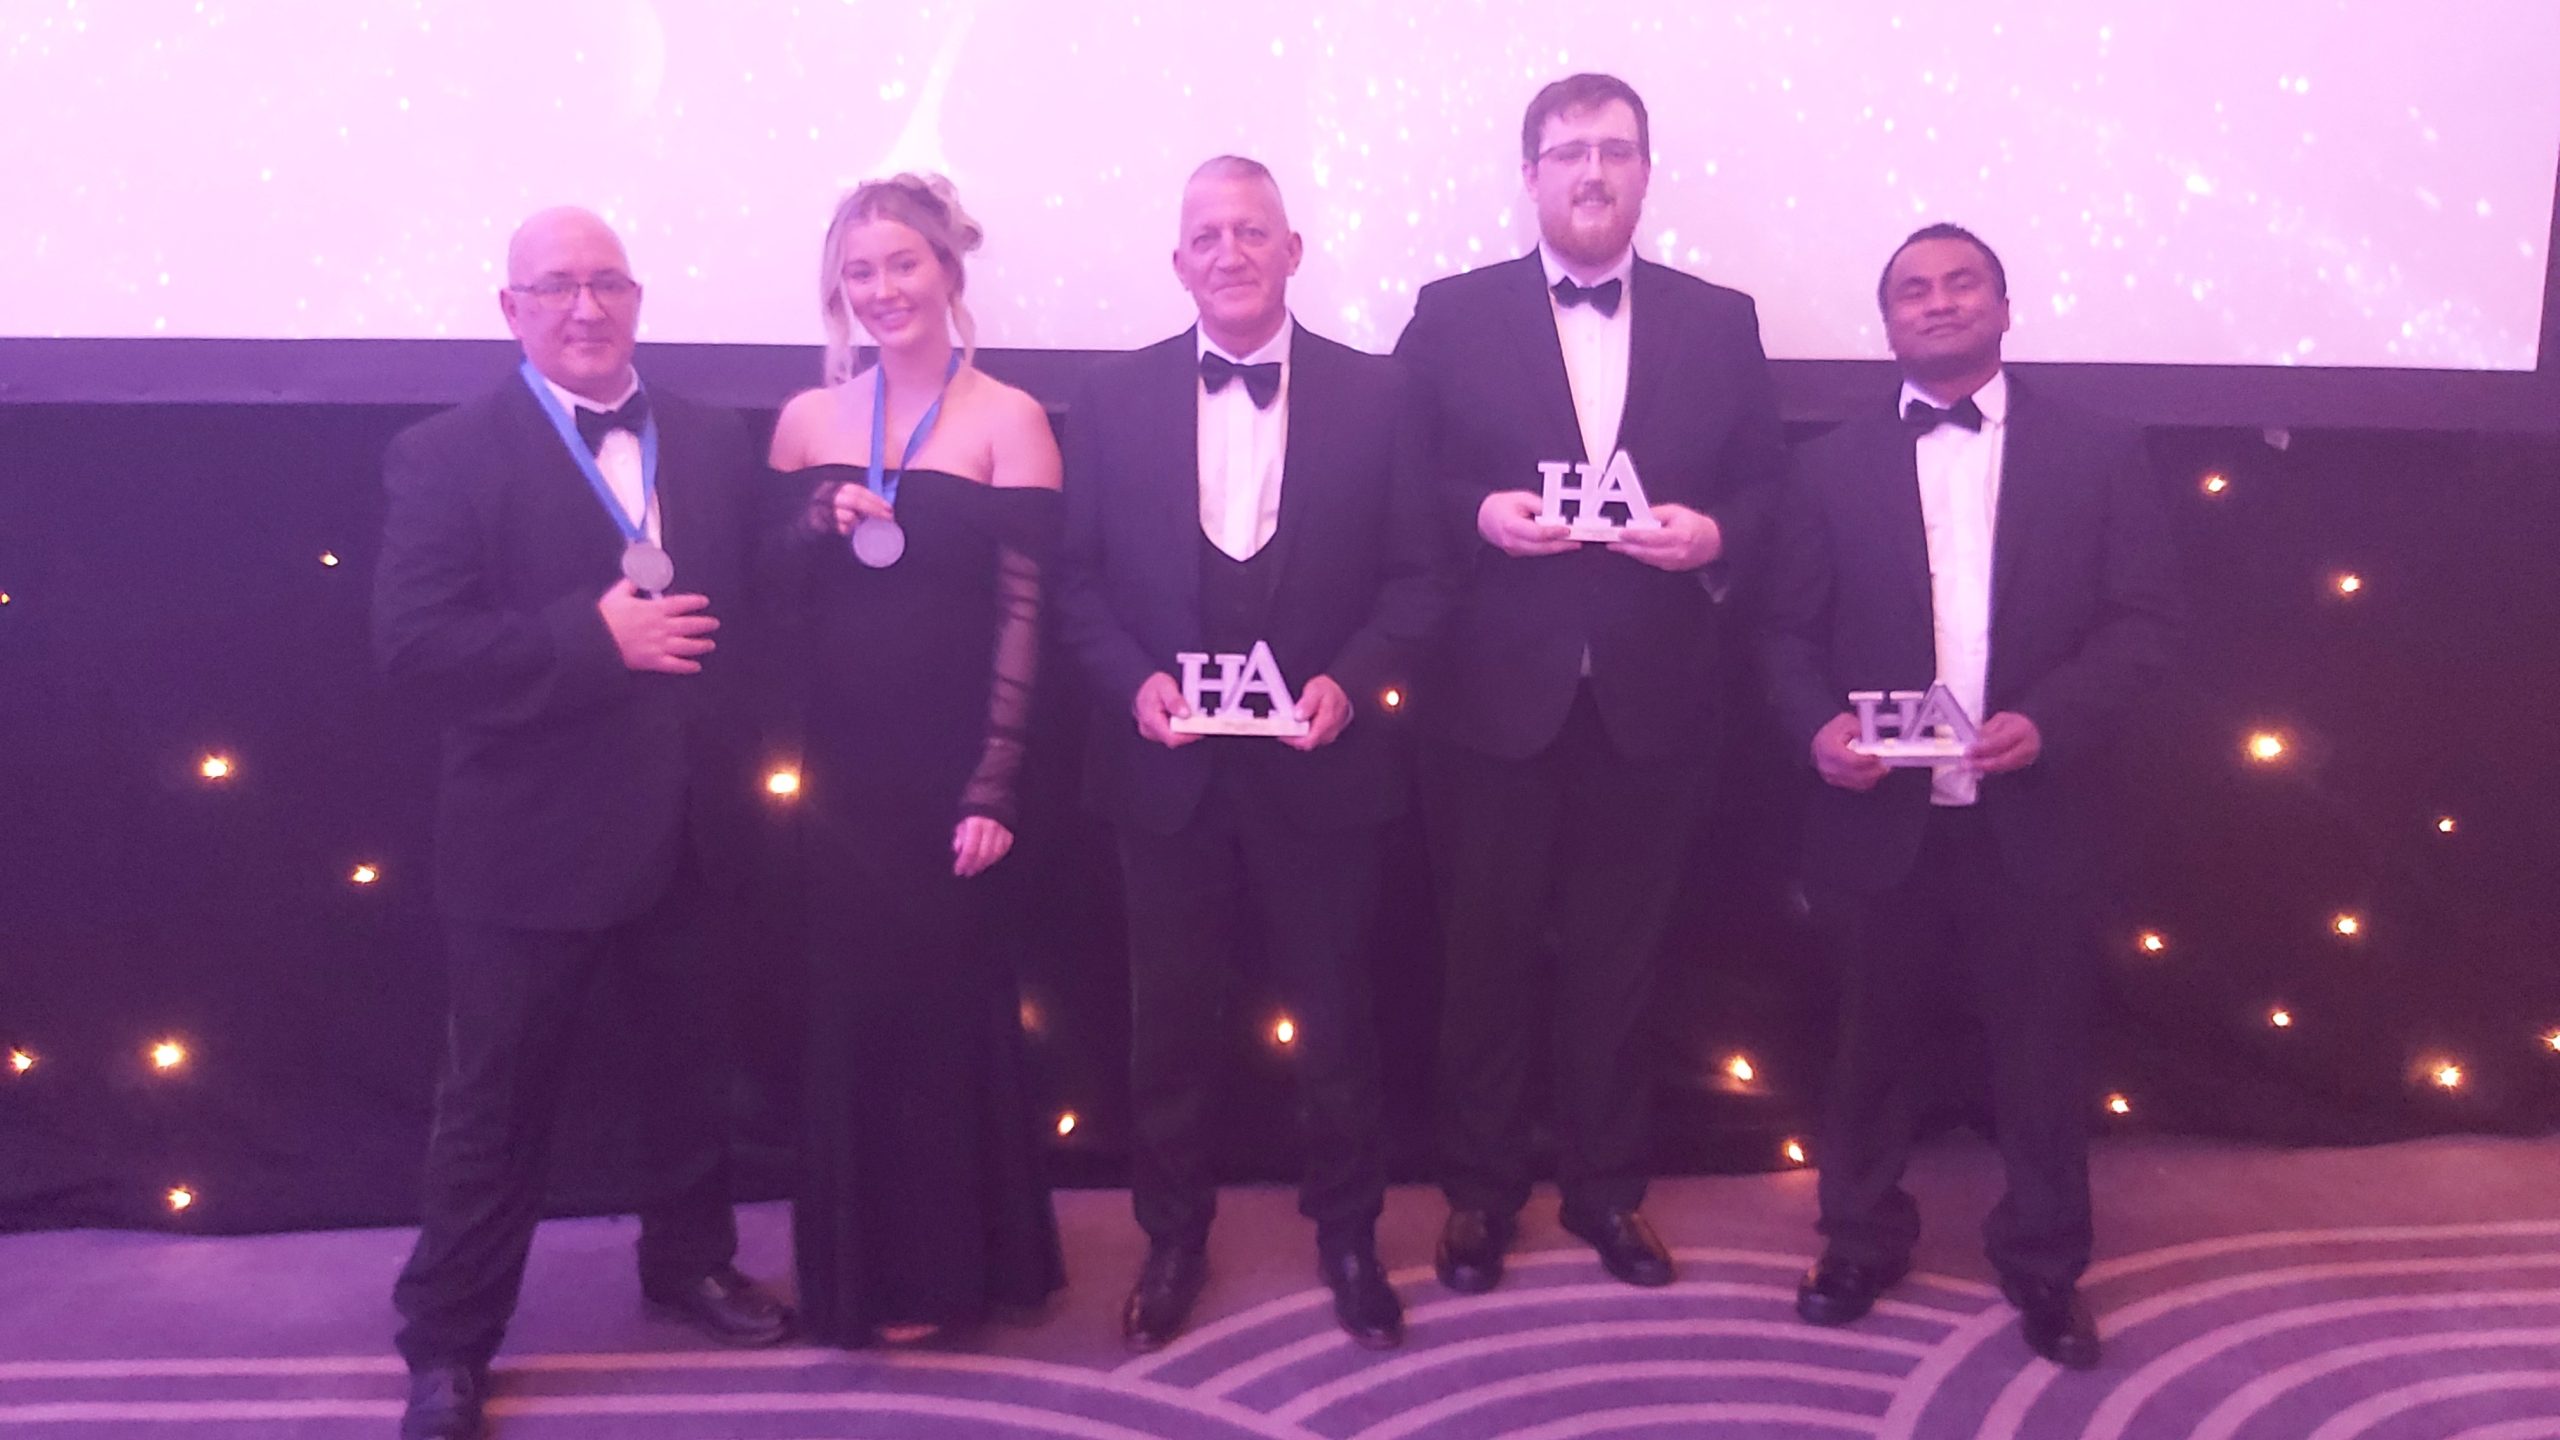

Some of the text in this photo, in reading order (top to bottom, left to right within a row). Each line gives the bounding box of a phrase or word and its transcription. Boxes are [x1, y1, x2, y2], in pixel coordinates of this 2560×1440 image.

[1535, 450, 1661, 528] HA
[1177, 640, 1296, 718] HA
[1848, 681, 1979, 743] HA
